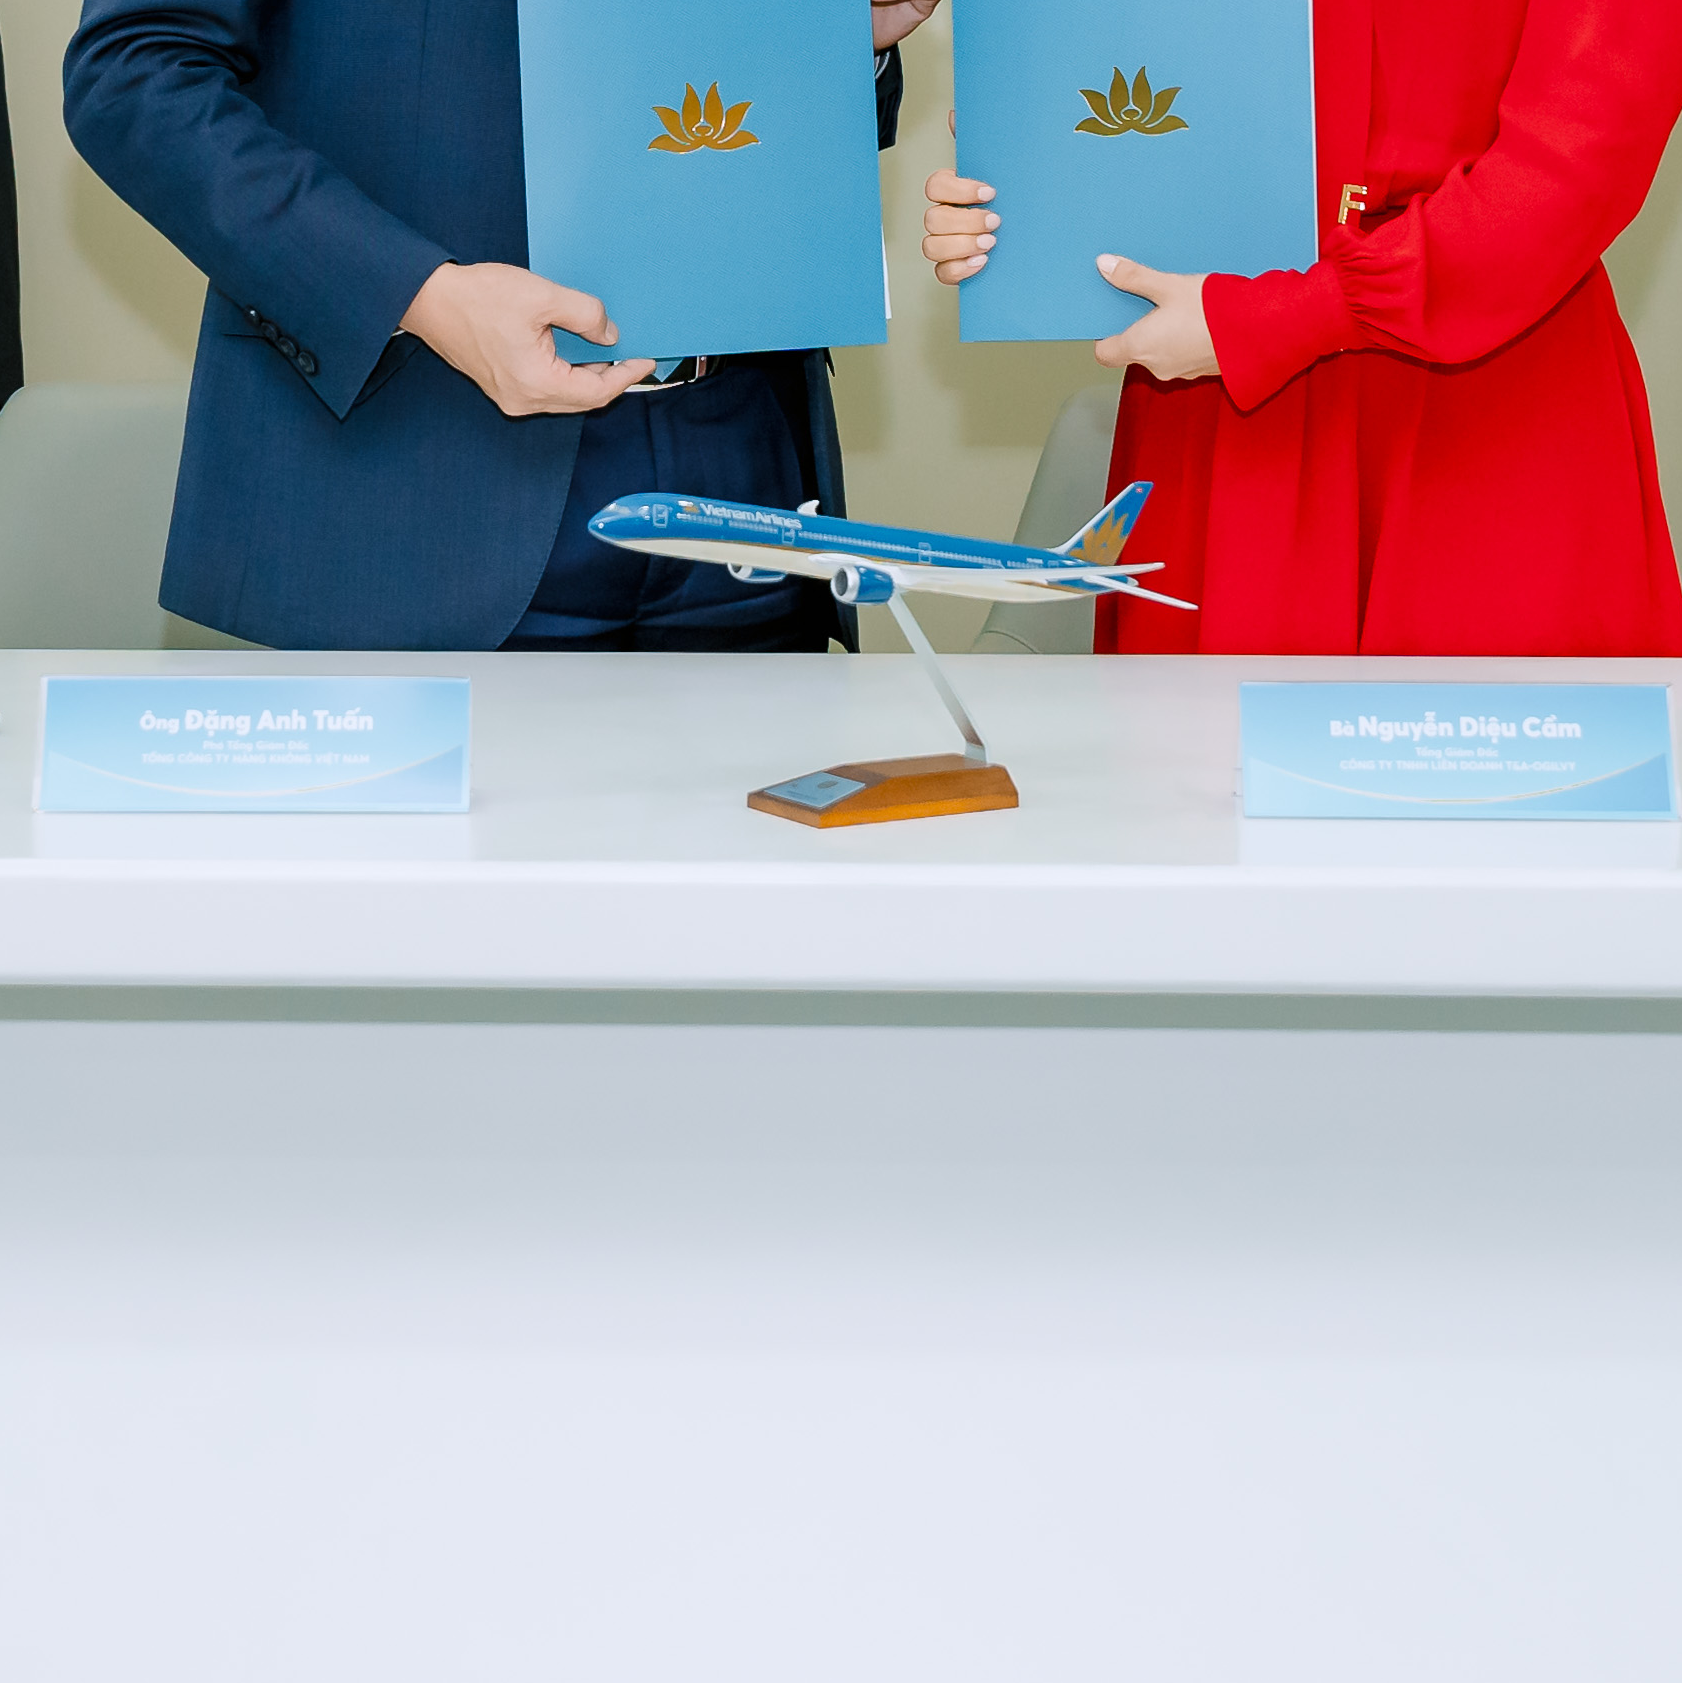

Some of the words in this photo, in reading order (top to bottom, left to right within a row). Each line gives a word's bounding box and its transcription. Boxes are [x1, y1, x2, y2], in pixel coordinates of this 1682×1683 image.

[699, 502, 755, 521] Vietnam
[754, 511, 803, 530] Airlines
[139, 709, 180, 735] Ông
[184, 709, 252, 737] Đặng
[256, 708, 307, 731] Anh
[312, 707, 374, 731] Tuấn
[1329, 719, 1356, 737] Bà
[1357, 711, 1455, 742] Nguyễn
[1459, 716, 1517, 744] Diệu
